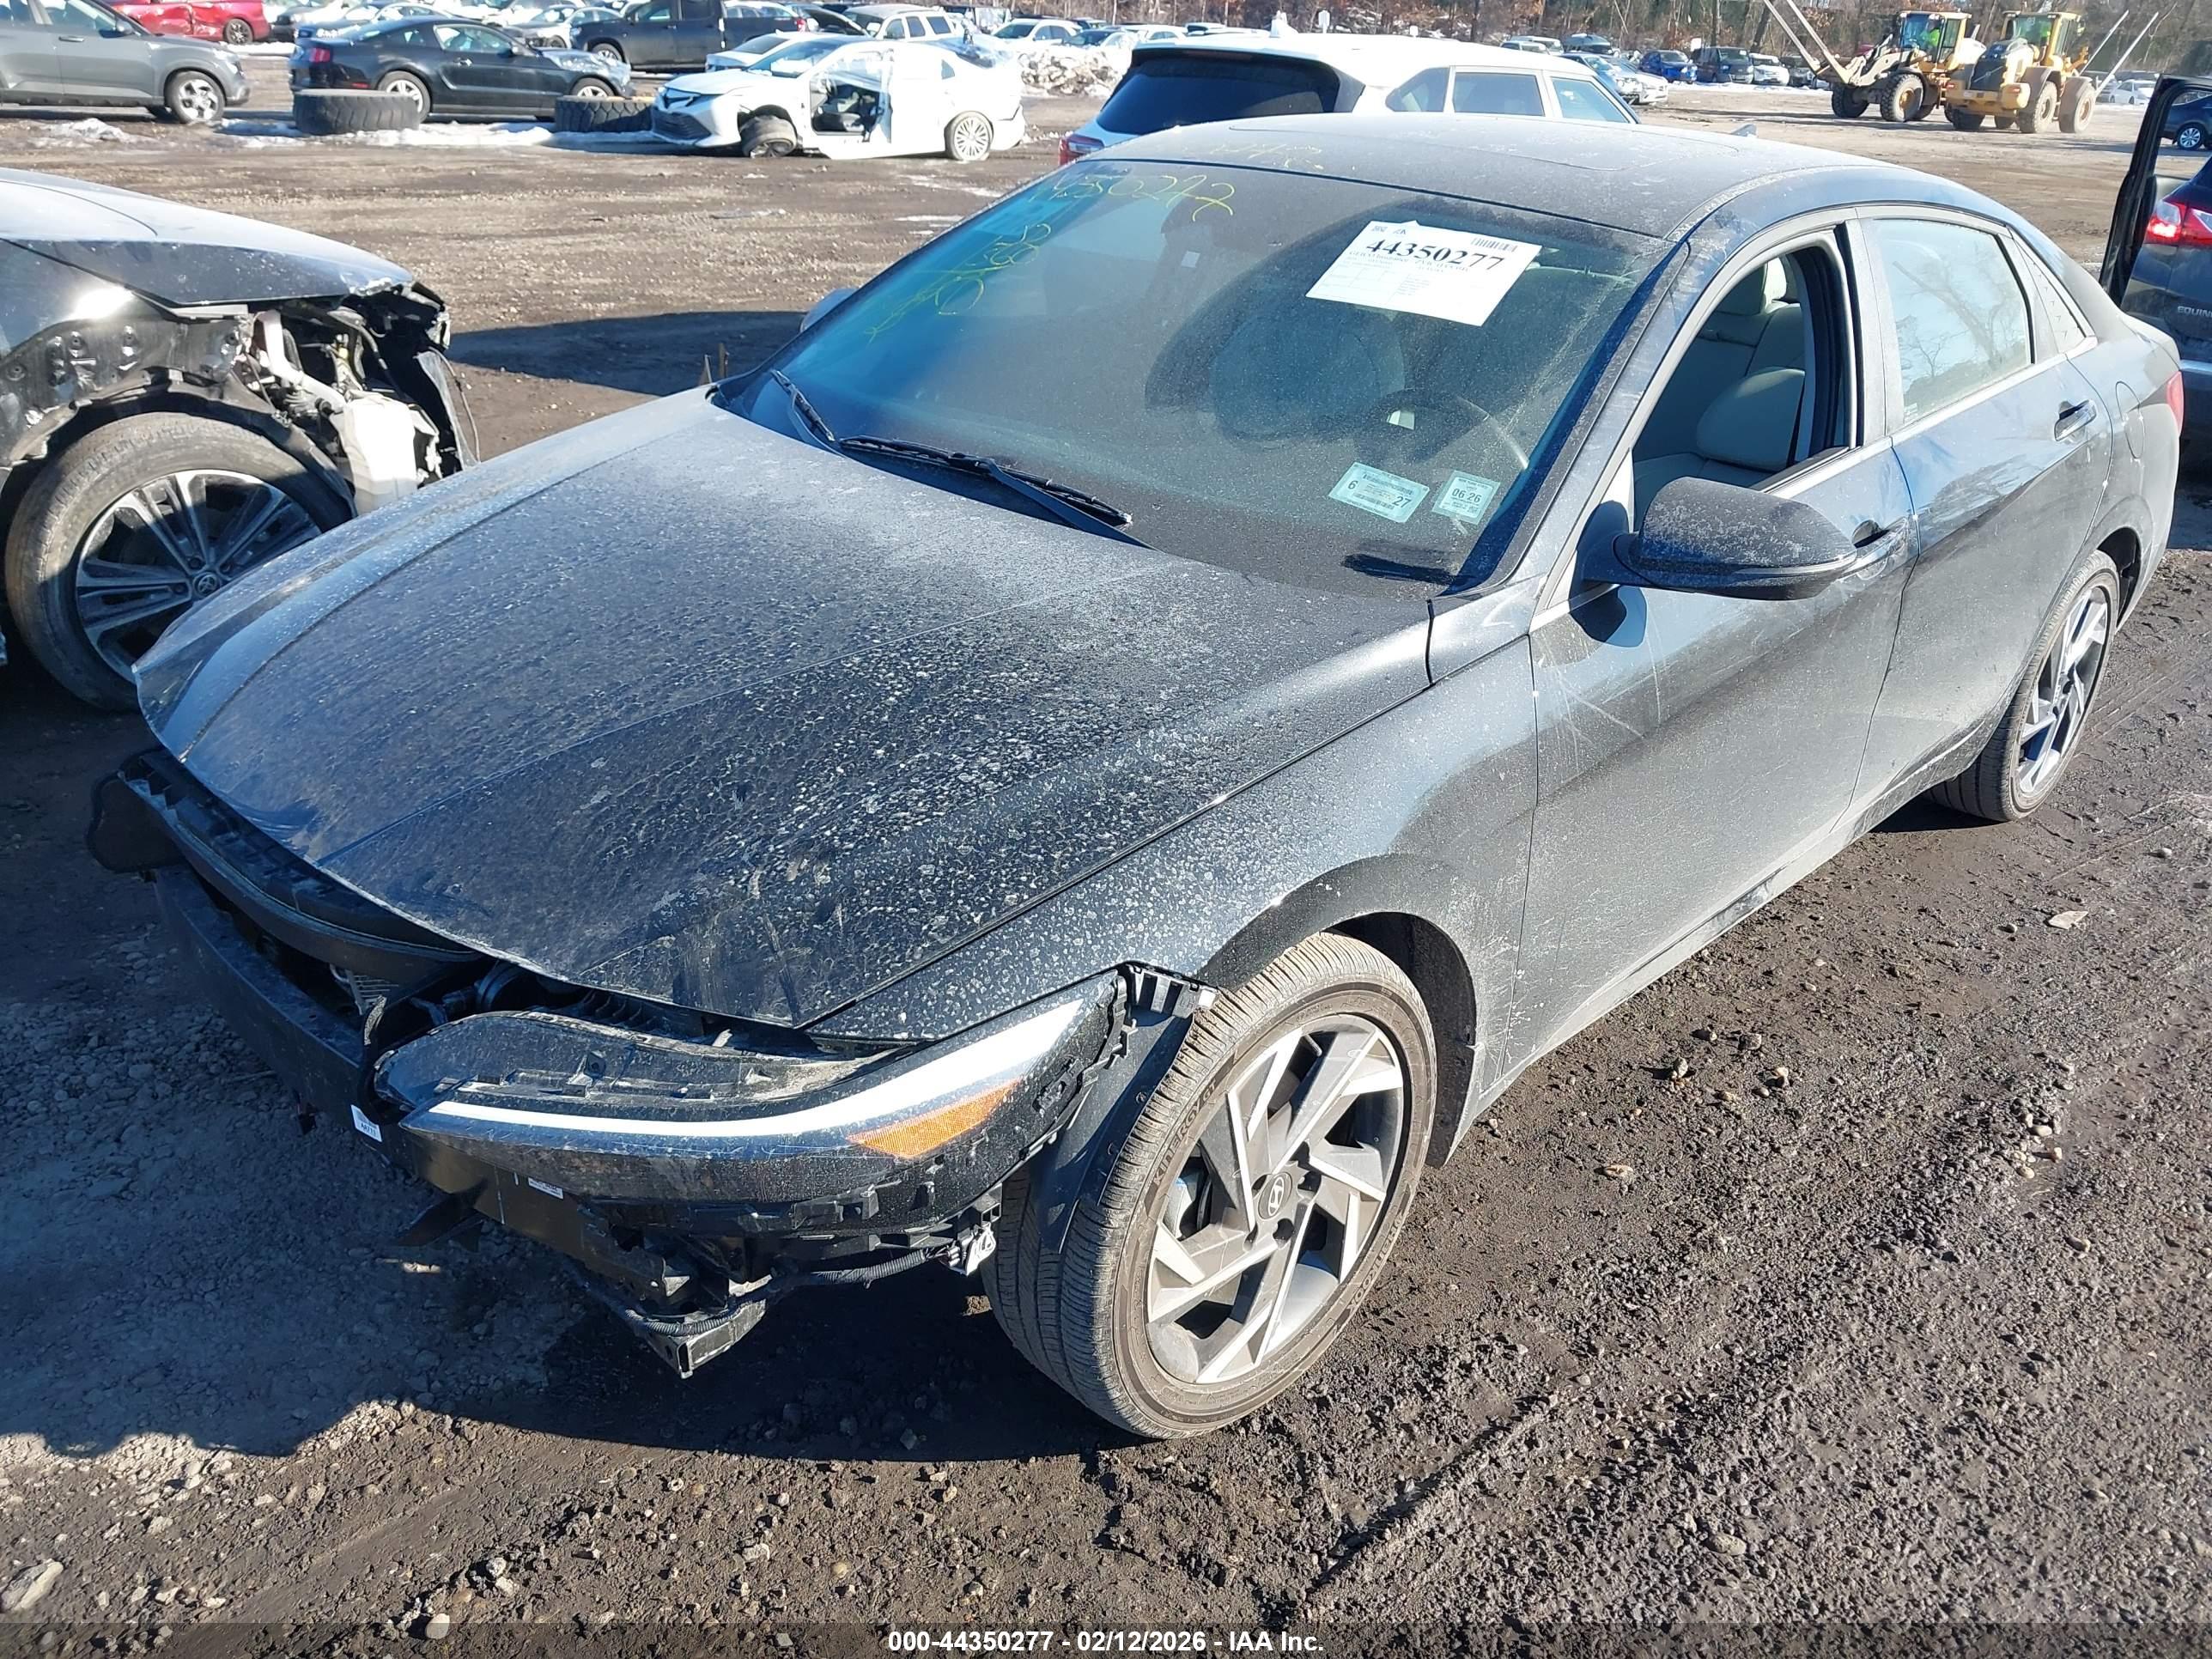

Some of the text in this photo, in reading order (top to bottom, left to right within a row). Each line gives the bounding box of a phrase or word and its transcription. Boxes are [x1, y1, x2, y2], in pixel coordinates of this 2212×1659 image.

[1366, 240, 1505, 270] 44350277
[1347, 480, 1358, 490] 6
[1393, 495, 1413, 508] 27
[1451, 487, 1482, 504] 06 26
